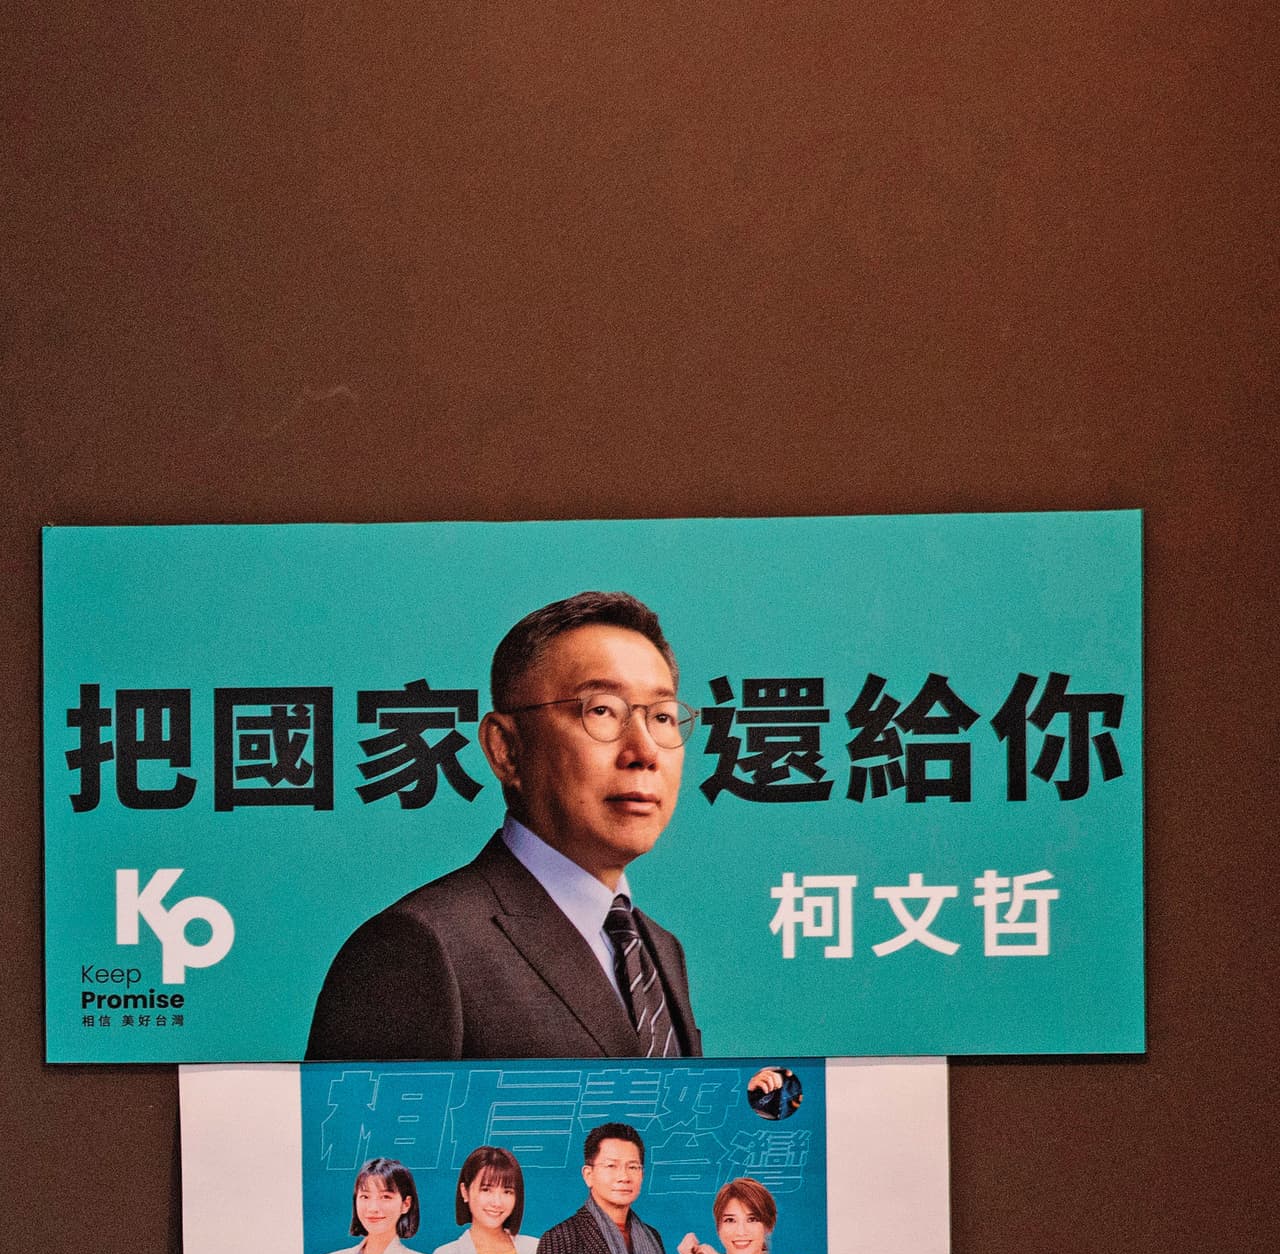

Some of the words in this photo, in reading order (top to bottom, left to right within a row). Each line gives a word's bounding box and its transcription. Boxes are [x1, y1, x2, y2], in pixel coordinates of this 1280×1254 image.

[64, 678, 485, 813] 把國家
[699, 672, 1125, 806] 還給你
[769, 870, 1060, 960] 柯文哲
[81, 964, 142, 989] Keep
[81, 988, 185, 1009] Promise
[82, 1014, 111, 1027] 相信
[121, 1014, 185, 1027] 美好台灣
[320, 1069, 582, 1171] 相信
